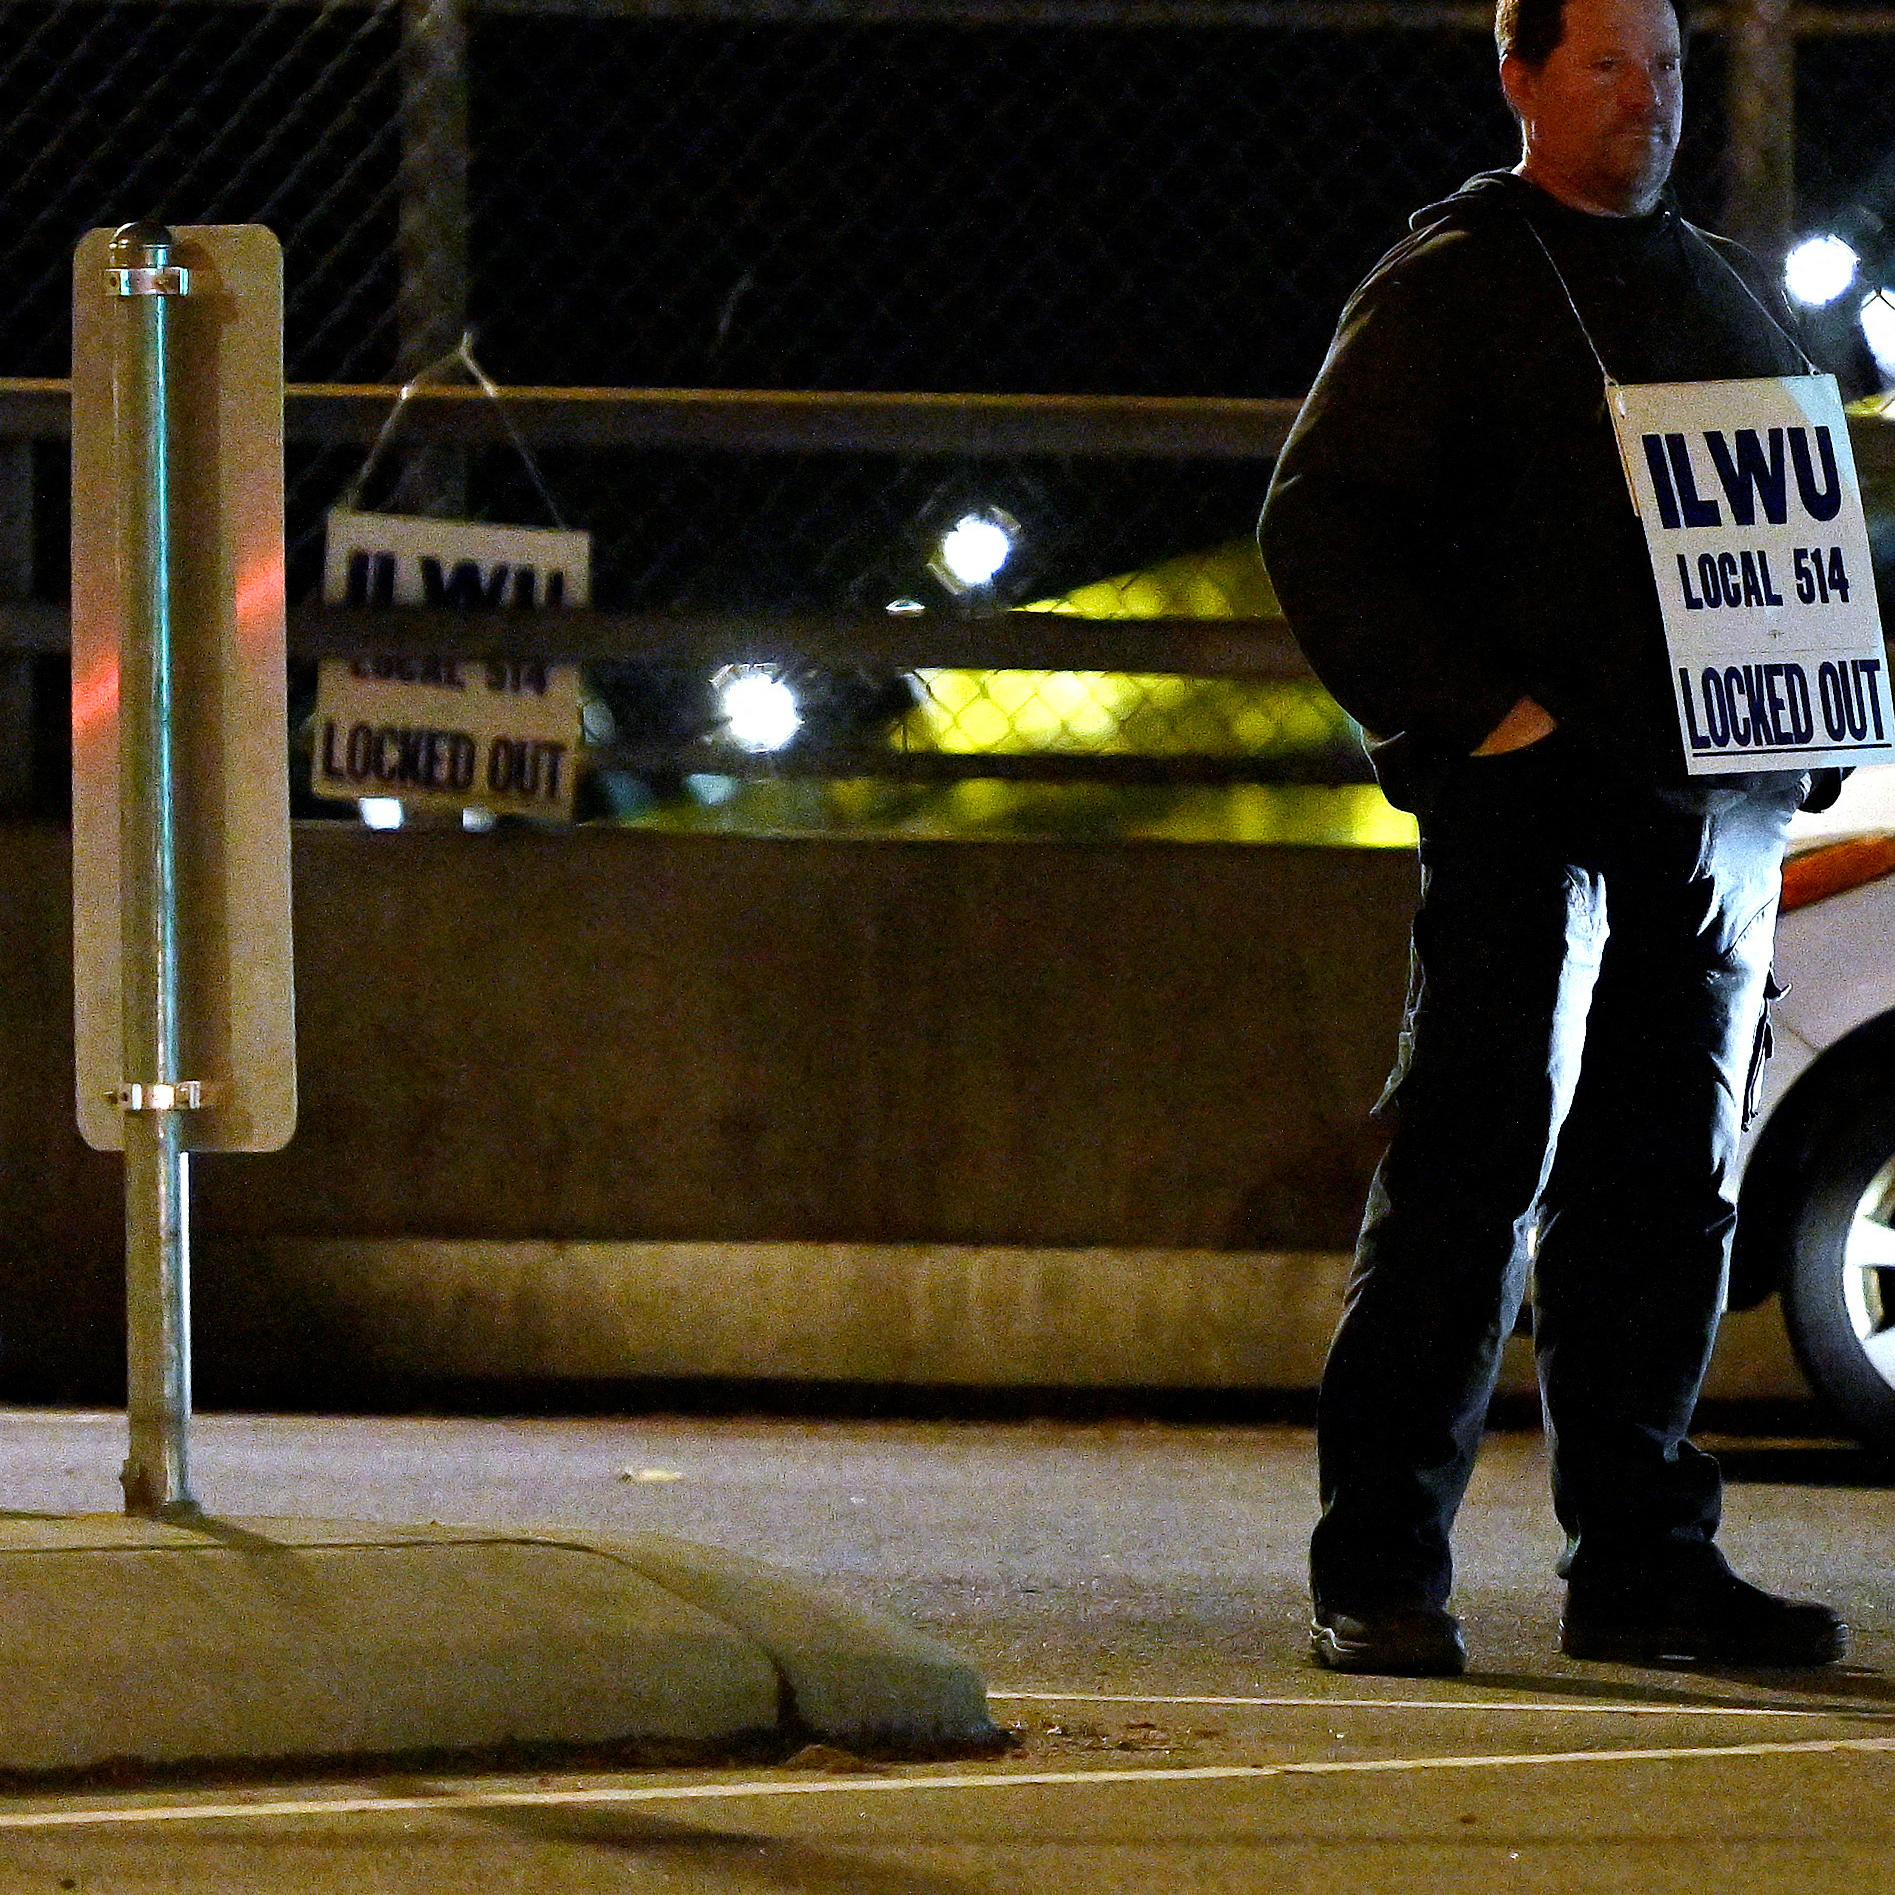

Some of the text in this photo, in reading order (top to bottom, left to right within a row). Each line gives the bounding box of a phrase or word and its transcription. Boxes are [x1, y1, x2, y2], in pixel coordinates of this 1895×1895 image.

[1641, 425, 1843, 529] ILWU
[1676, 547, 1850, 610] LOCAL 514
[1678, 659, 1886, 750] LOCKED OUT
[322, 720, 566, 798] LOCKED OUT
